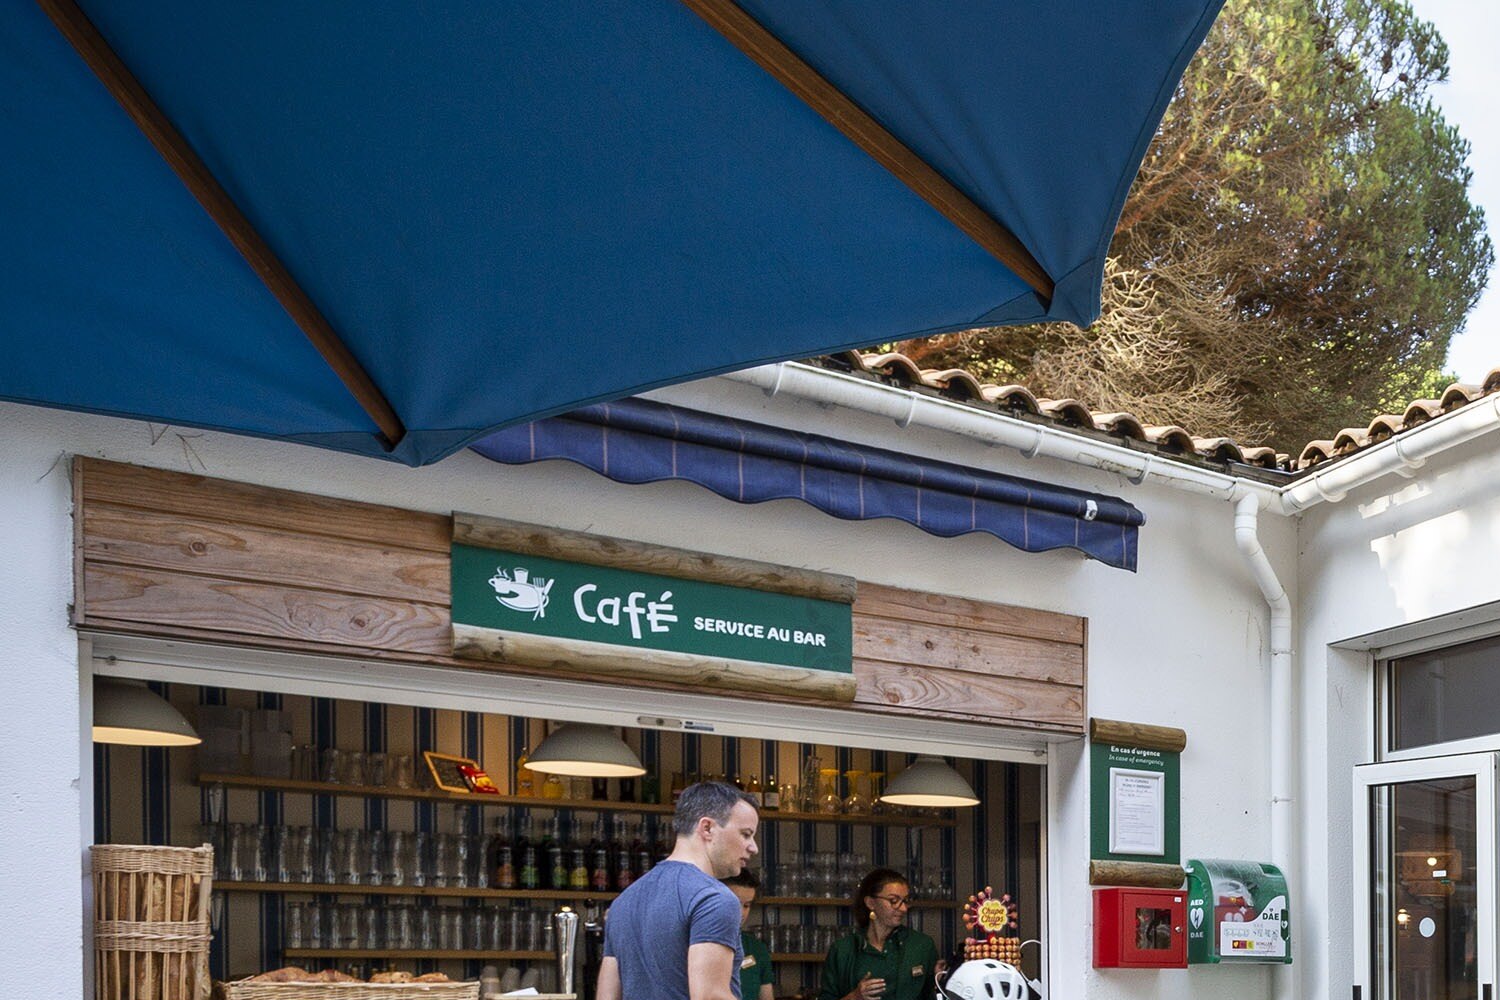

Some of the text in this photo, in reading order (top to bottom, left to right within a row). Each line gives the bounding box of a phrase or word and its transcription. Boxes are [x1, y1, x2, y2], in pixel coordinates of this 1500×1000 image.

[573, 583, 826, 648] Café SERVICE AU BAR
[1110, 745, 1120, 753] En
[1131, 747, 1161, 757] d'urgence
[1129, 756, 1136, 764] of
[1135, 758, 1164, 766] emergency
[1262, 912, 1280, 921] DAE
